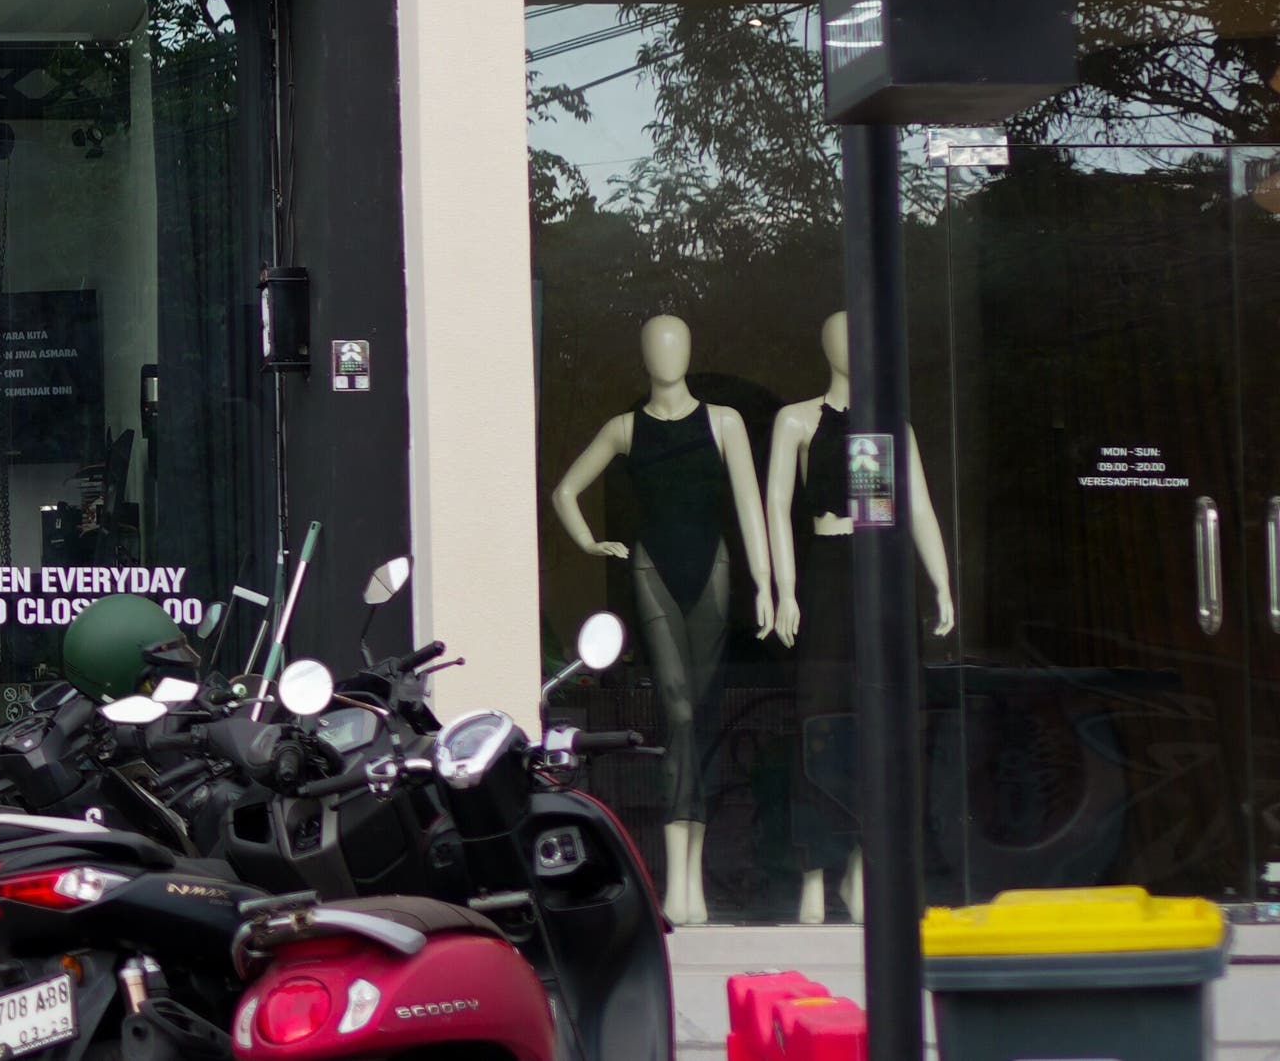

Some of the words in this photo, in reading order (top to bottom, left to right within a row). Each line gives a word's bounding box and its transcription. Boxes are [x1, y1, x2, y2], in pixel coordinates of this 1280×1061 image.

[41, 566, 187, 594] EVERYDAY
[17, 597, 101, 626] CLOS
[394, 998, 480, 1019] SCOOPY
